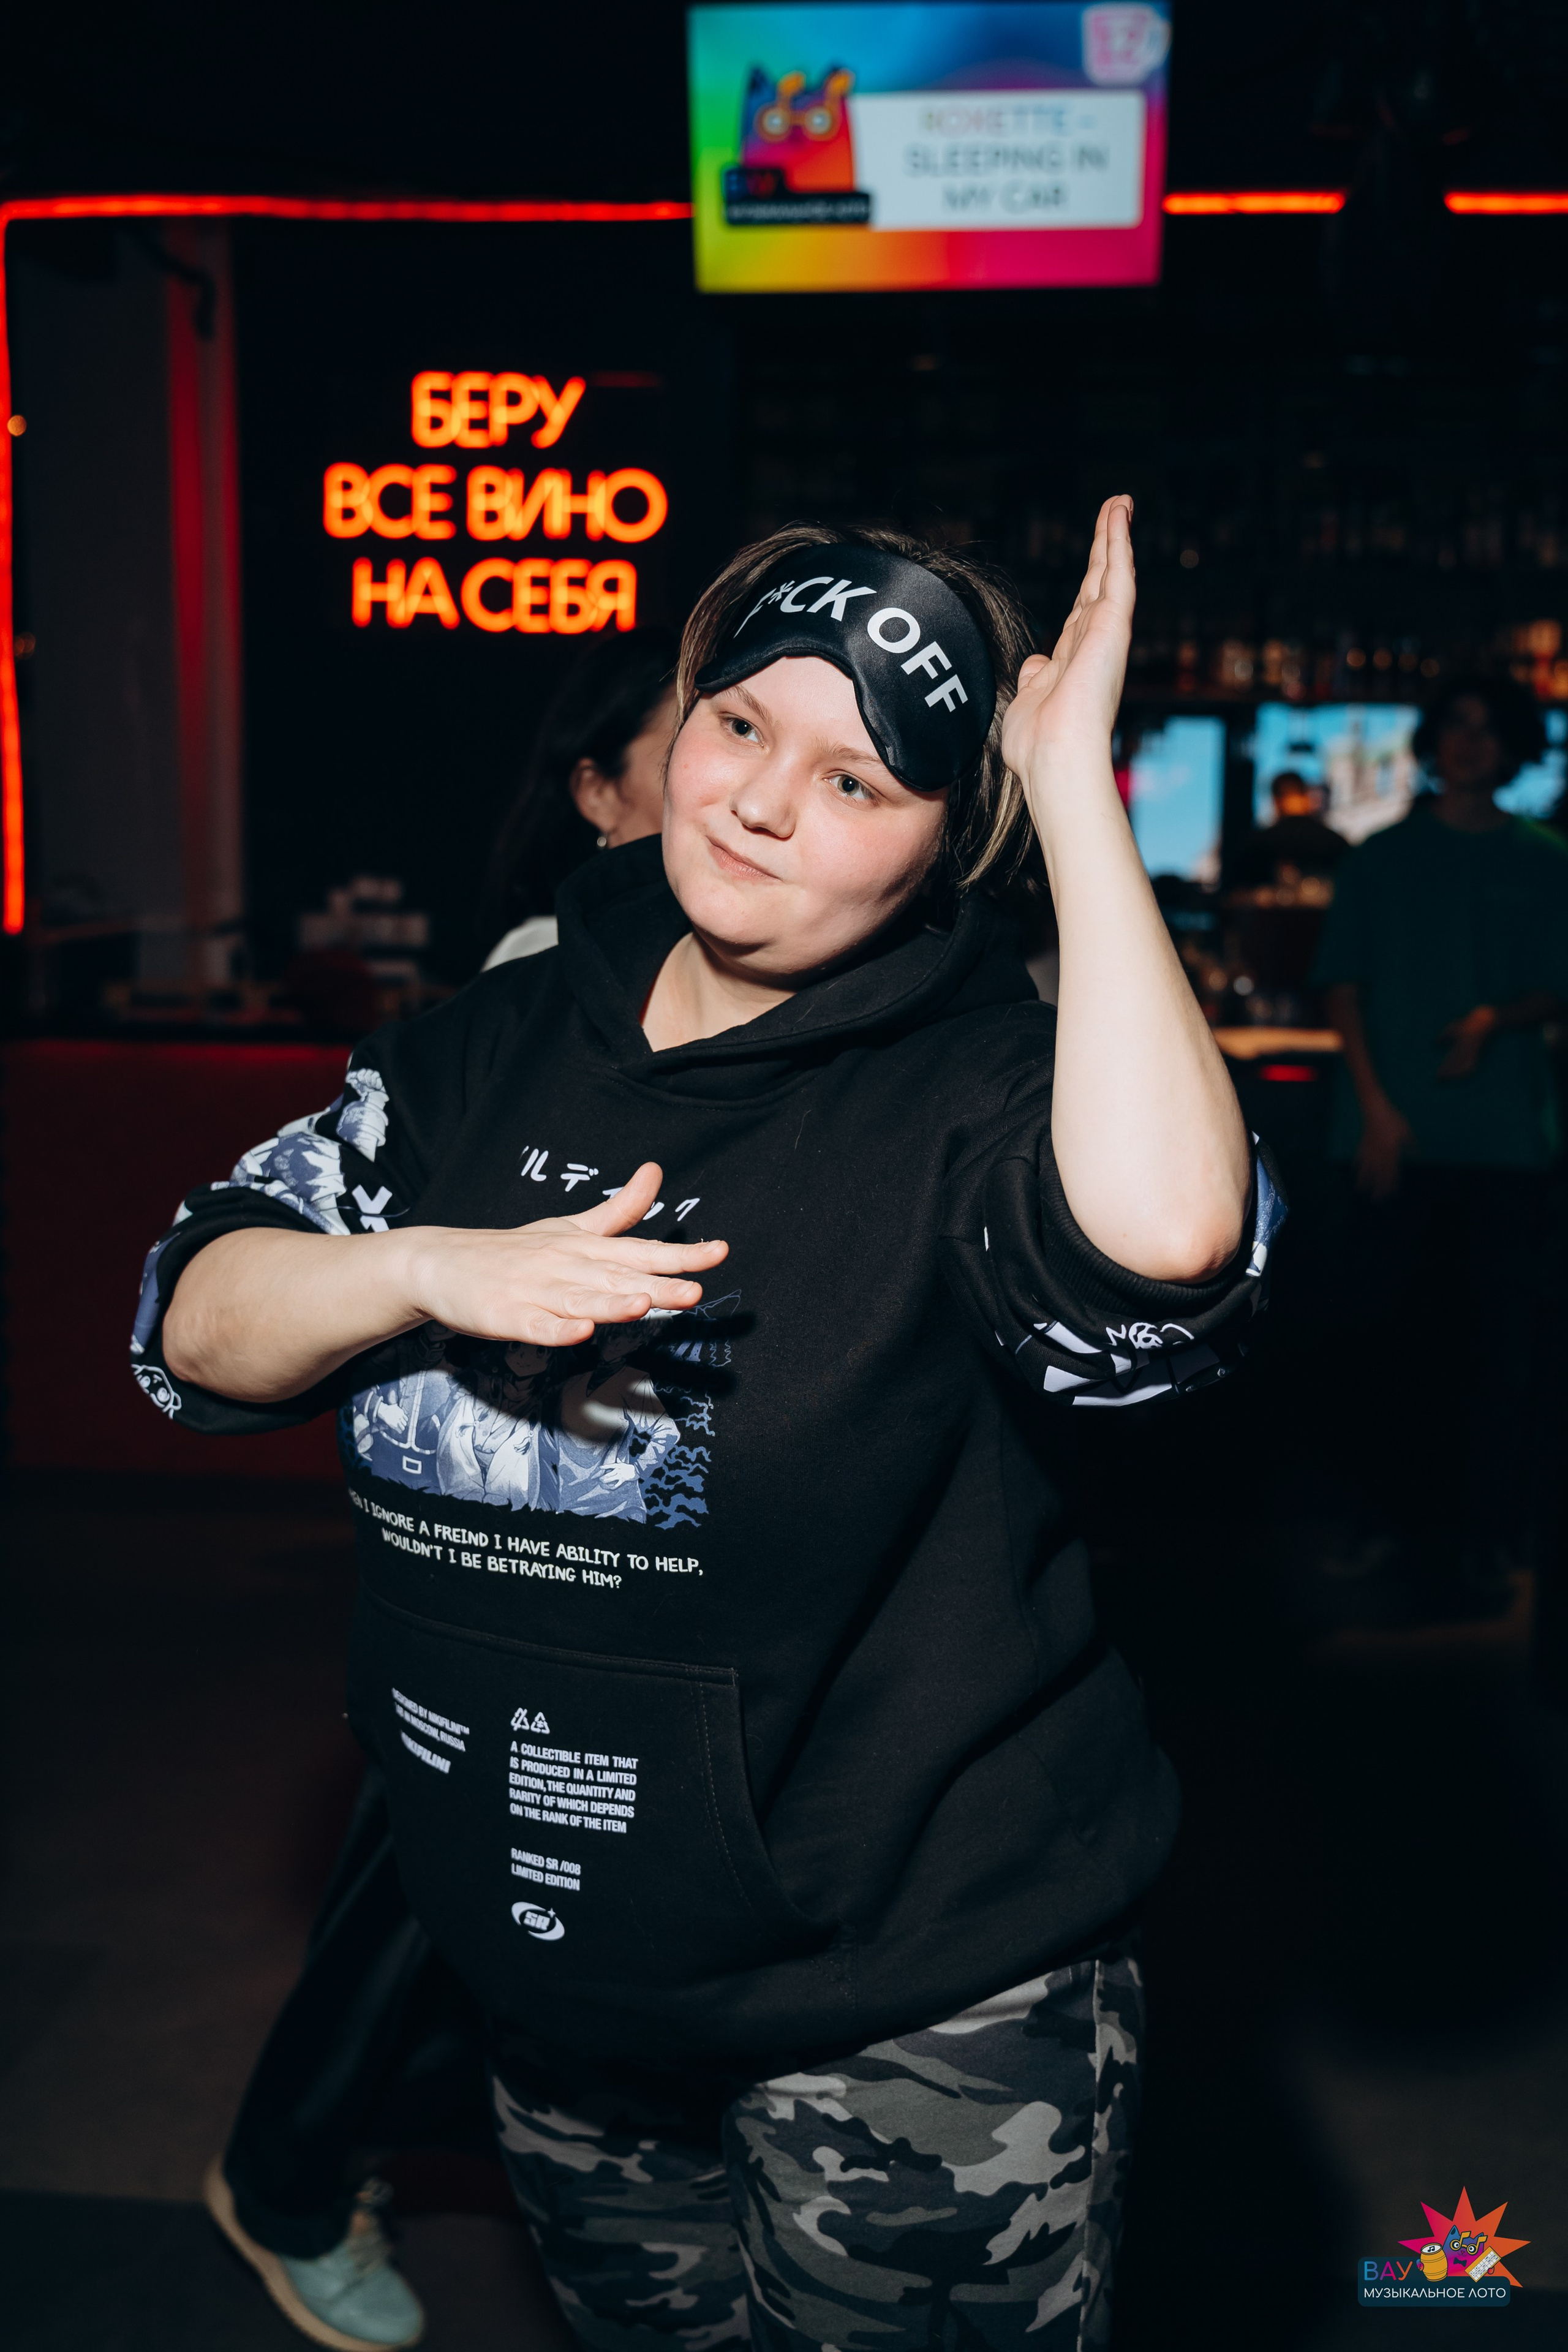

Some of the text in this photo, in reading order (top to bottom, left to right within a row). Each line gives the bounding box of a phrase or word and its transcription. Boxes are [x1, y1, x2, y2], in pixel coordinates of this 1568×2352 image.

[903, 143, 1109, 177] SLEEPING IN
[999, 181, 1069, 213] CAR
[412, 371, 586, 448] БЕРУ
[323, 462, 668, 543] ВСЕ ВИНО
[352, 557, 637, 634] НА СЕБЯ
[867, 608, 968, 712] OFF
[371, 1502, 414, 1532] IGNORE
[419, 1520, 430, 1536] A
[434, 1523, 488, 1547] FREIND
[494, 1534, 502, 1550] I
[508, 1536, 550, 1556] HAVE
[556, 1544, 620, 1567] ABILITY
[627, 1554, 649, 1570] TO
[655, 1556, 703, 1576] HELP,
[382, 1527, 622, 1588] WOULDN'T I BE BETRAYING HIM?
[440, 1730, 466, 1752] RUSSIA
[510, 1741, 638, 1770] A COLLECTIBLE ITEM THAT
[510, 1756, 636, 1785] IS PRODUCED IN A LIMITED
[509, 1772, 636, 1801] EDITION, THE QUANTITY AND
[509, 1787, 635, 1818] RARITY OF WHICH DEPENDS
[510, 1803, 627, 1833] ON THE RANK OF THE ITEM
[511, 1847, 545, 1868] RANKED
[545, 1857, 559, 1871] SR
[511, 1863, 580, 1891] LIMITED EDITION
